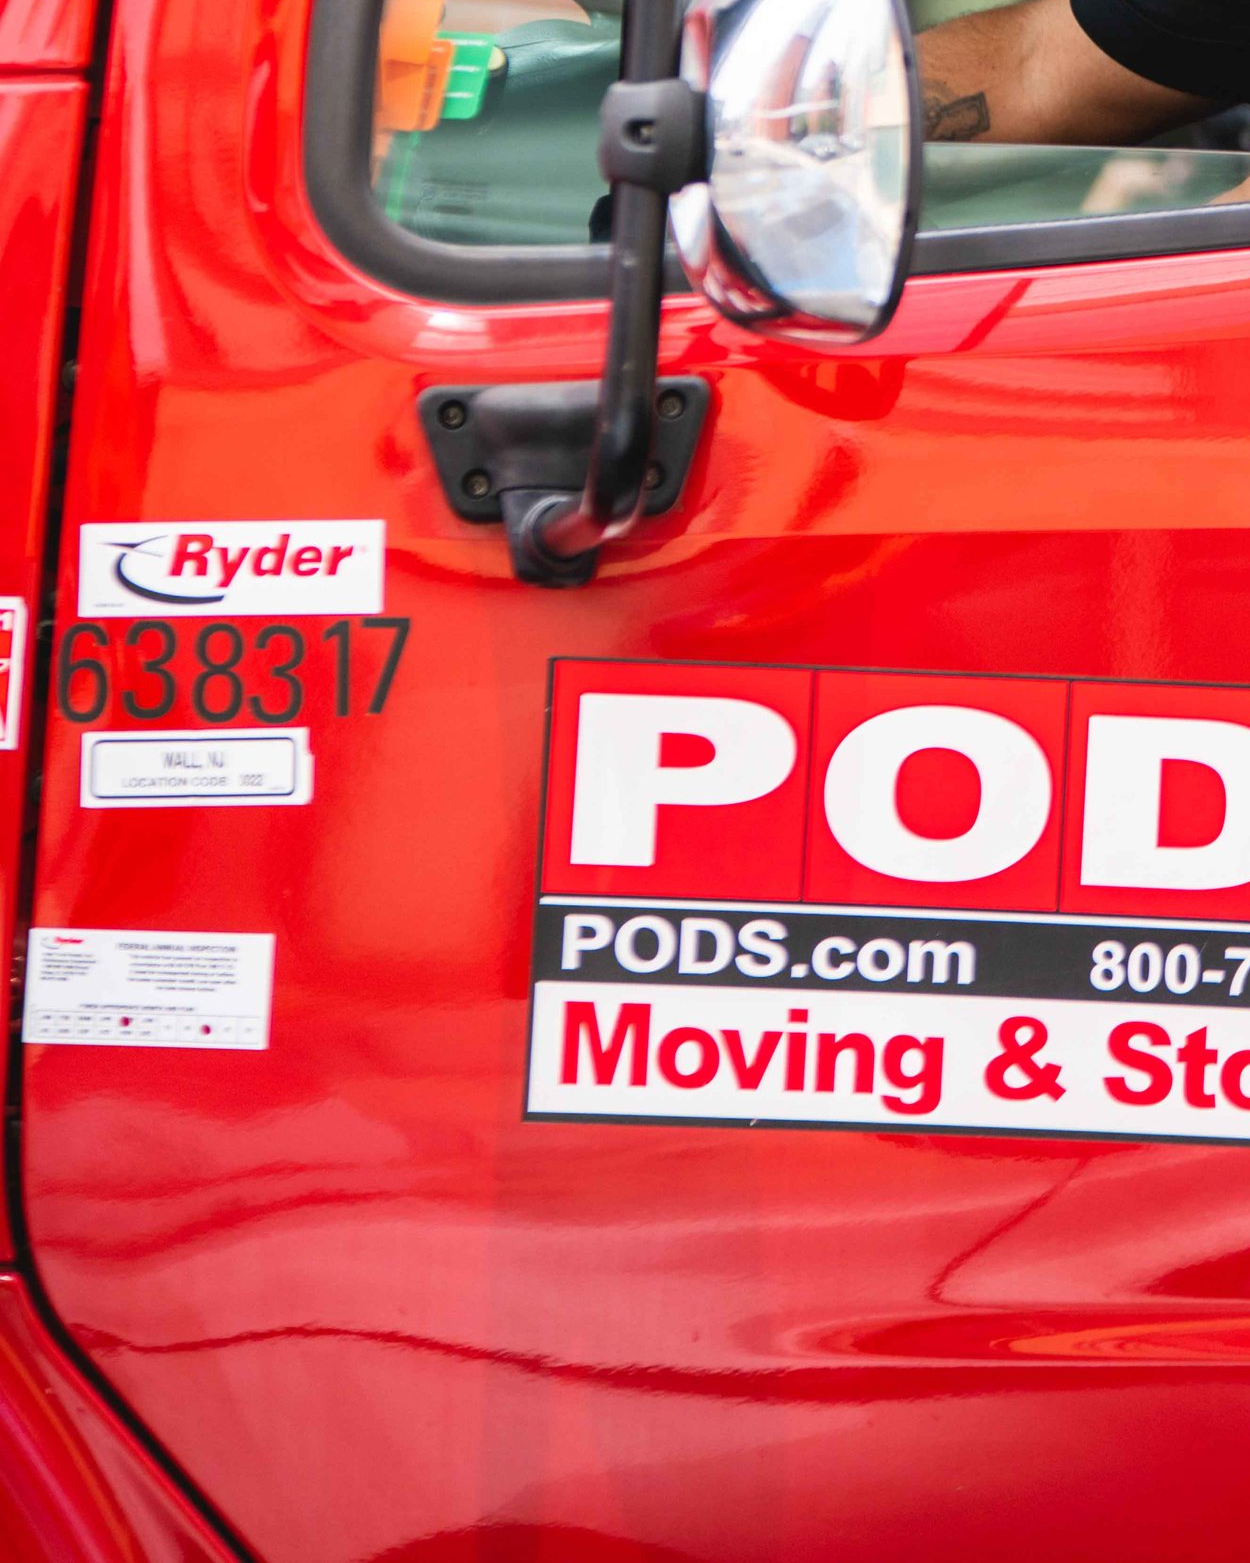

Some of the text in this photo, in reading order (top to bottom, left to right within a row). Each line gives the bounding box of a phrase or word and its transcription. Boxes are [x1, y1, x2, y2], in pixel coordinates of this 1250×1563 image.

[167, 533, 354, 589] Ryder
[58, 616, 411, 725] 638317
[122, 776, 188, 789] LOCATION
[192, 776, 228, 788] CODE
[560, 913, 977, 985] PODS.com
[558, 999, 946, 1115] Moving
[983, 1015, 1067, 1103] &
